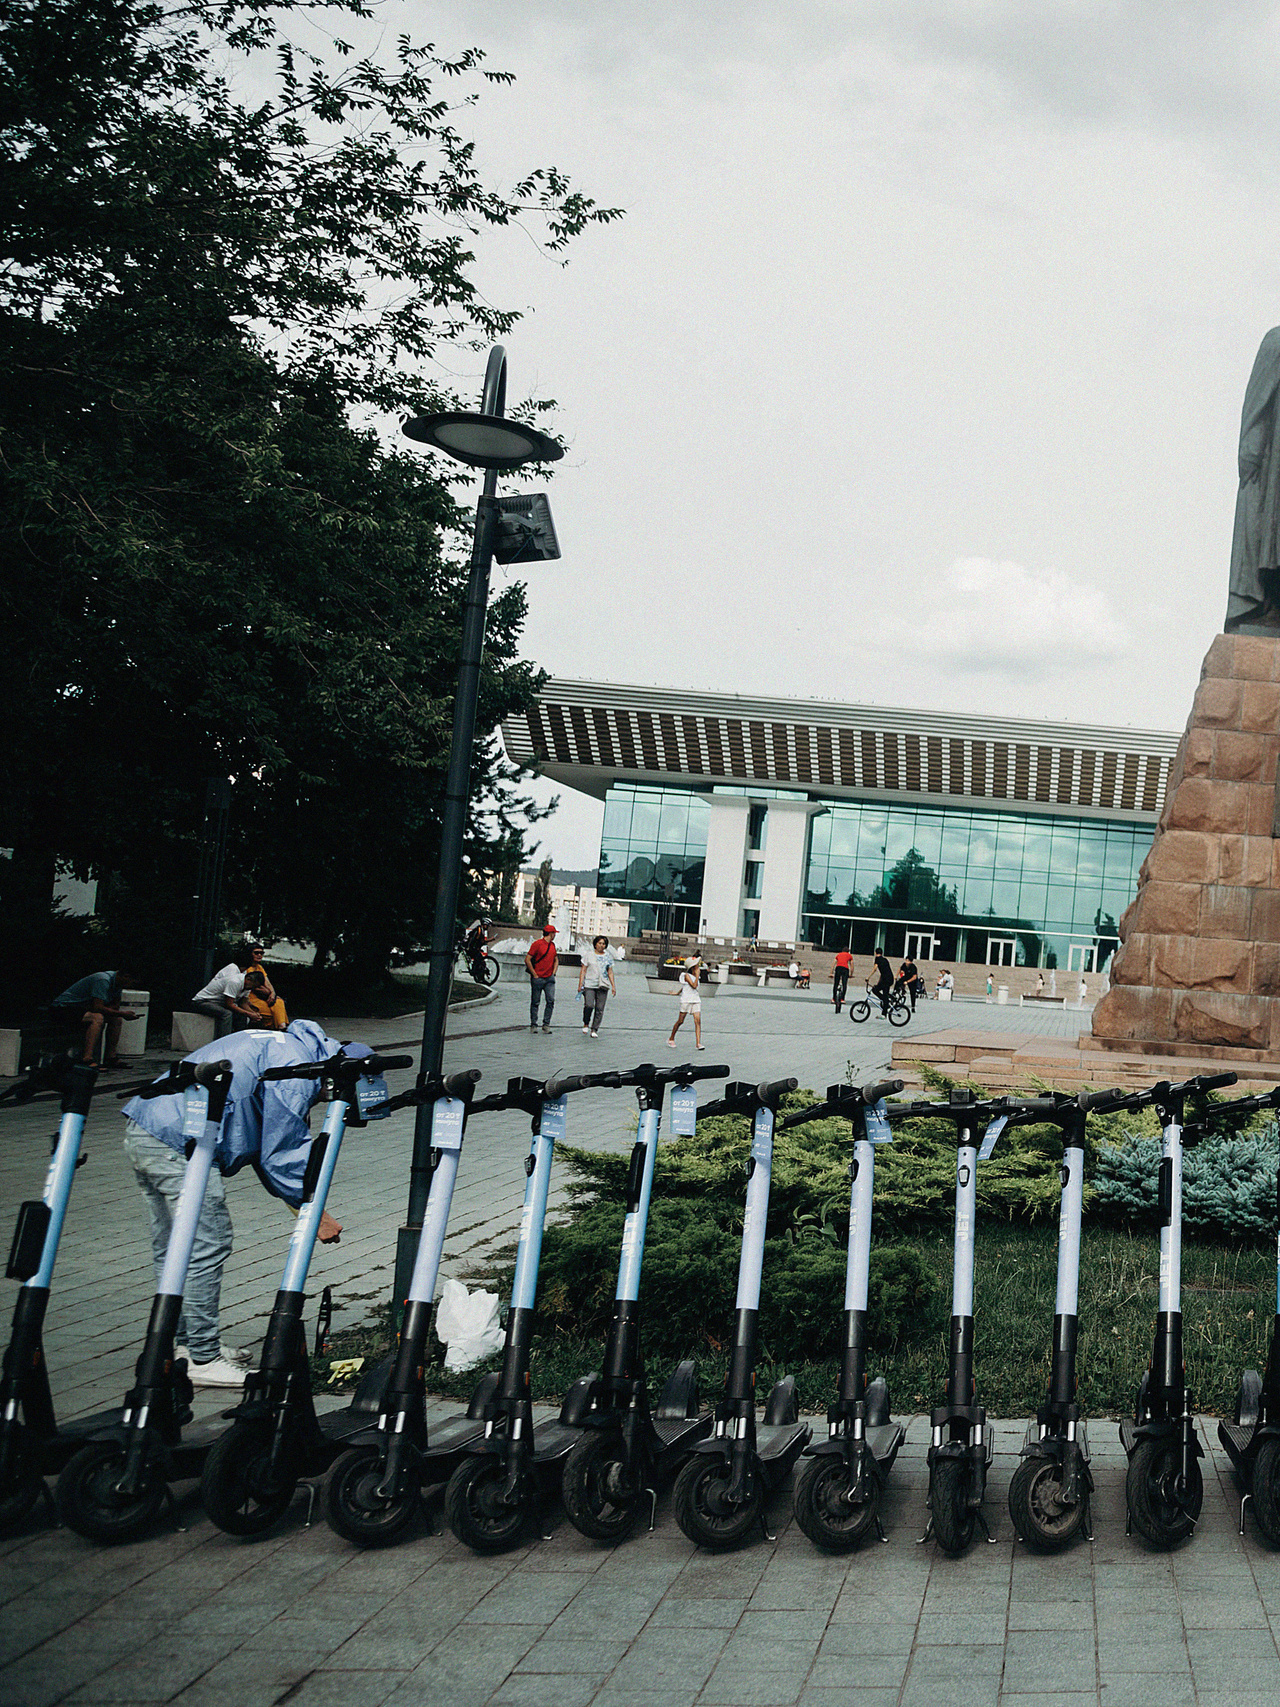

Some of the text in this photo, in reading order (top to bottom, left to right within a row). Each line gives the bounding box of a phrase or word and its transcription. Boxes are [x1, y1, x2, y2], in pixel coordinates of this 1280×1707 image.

[849, 1206, 858, 1236] JET
[957, 1211, 970, 1241] JET
[1059, 1212, 1068, 1240] JET
[622, 1218, 637, 1258] JET
[1160, 1251, 1172, 1289] JET
